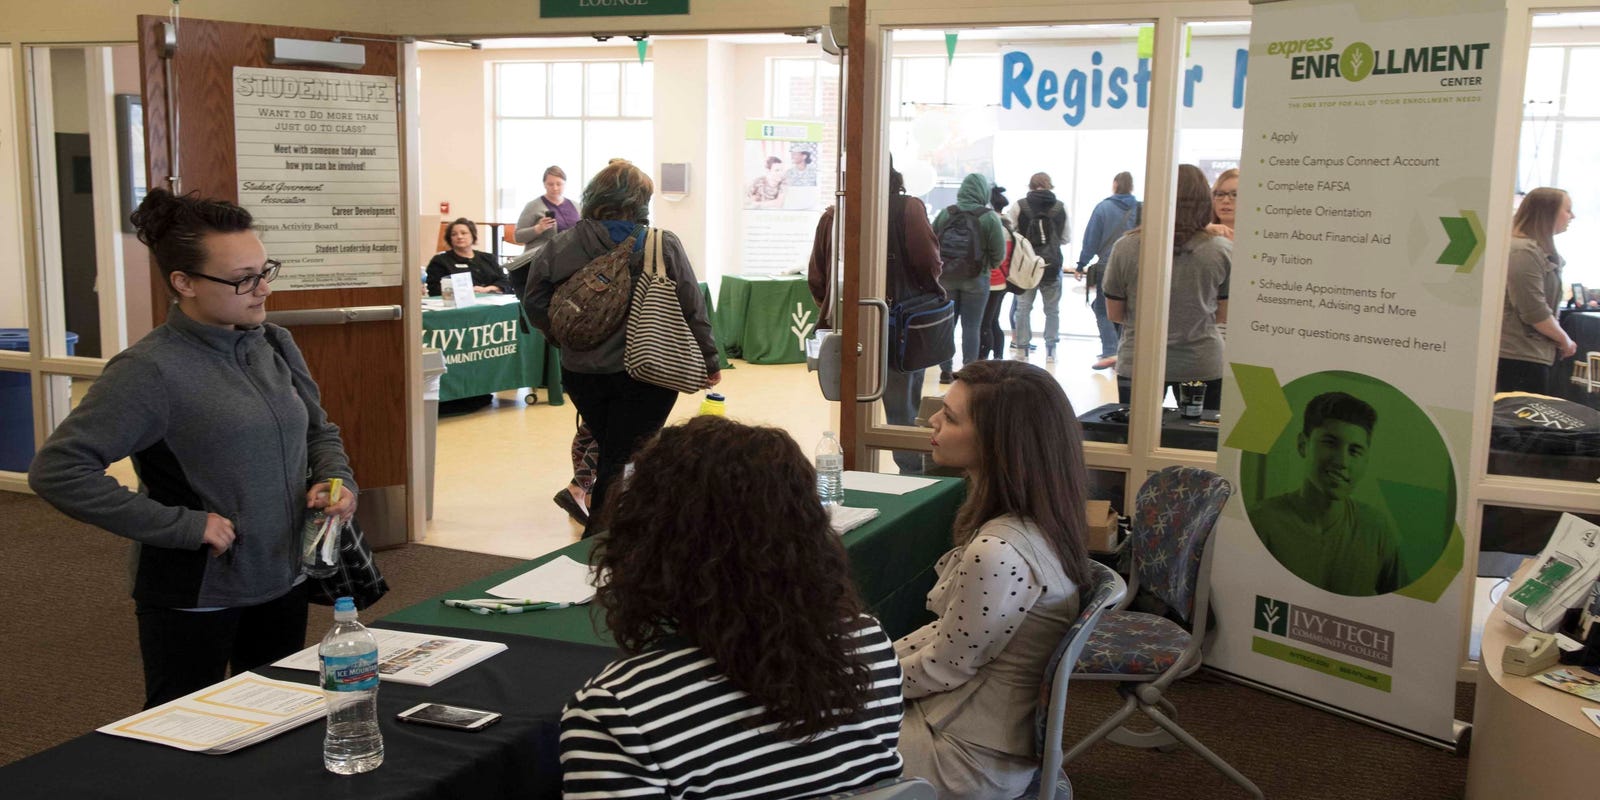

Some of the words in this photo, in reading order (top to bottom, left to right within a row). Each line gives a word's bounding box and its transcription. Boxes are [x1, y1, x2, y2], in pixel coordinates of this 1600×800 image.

[1267, 36, 1334, 58] express
[236, 73, 342, 101] STUDENT
[344, 79, 389, 103] LIFE
[1440, 76, 1482, 87] CENTER
[1001, 51, 1203, 127] Registr
[258, 108, 290, 118] WANT
[294, 110, 306, 119] TO
[310, 110, 323, 119] DO
[327, 112, 353, 120] MORE
[356, 113, 379, 121] THAN
[275, 122, 301, 131] JUST
[304, 124, 317, 132] GO
[320, 124, 332, 132] TO
[335, 124, 367, 133] CLASS?
[1270, 132, 1298, 144] Apply
[274, 143, 292, 155] Meet
[293, 145, 309, 156] with
[310, 147, 340, 156] someone
[341, 146, 359, 158] today
[360, 147, 377, 156] about
[285, 160, 300, 170] how
[301, 162, 314, 172] you
[315, 162, 327, 171] can
[328, 161, 337, 171] be
[338, 161, 366, 171] involved!
[1268, 156, 1300, 167] Create
[1302, 155, 1344, 168] Campus
[1346, 156, 1390, 167] Connect
[1393, 156, 1440, 167] Account
[242, 181, 274, 191] Student
[275, 182, 324, 194] Government
[1266, 180, 1314, 193] Complete
[1317, 181, 1351, 191] FAFSA
[260, 195, 307, 204] Association
[331, 206, 354, 216] Career
[355, 207, 396, 217] Development
[1265, 205, 1313, 217] Complete
[1315, 205, 1372, 218] Orientation
[281, 223, 312, 231] Activity
[314, 222, 338, 230] Board
[1263, 229, 1289, 240] Learn
[1291, 230, 1323, 242] About
[1325, 232, 1368, 244] Financial
[1370, 234, 1391, 245] Aid
[315, 245, 340, 254] Student
[340, 244, 371, 253] Leadership
[373, 243, 398, 252] Academy
[1261, 252, 1278, 265] Pay
[1280, 253, 1312, 265] Tuition
[1259, 279, 1302, 292] Schedule
[1305, 282, 1377, 299] Appointments
[1380, 288, 1397, 299] for
[1256, 293, 1315, 308] Assessment,
[1318, 299, 1361, 314] Advising
[1363, 304, 1385, 314] and
[1388, 305, 1417, 317] More
[431, 328, 466, 350] IVY
[469, 320, 517, 348] TECH
[1250, 320, 1269, 333] Get
[1271, 325, 1295, 336] your
[1297, 328, 1351, 342] questions
[1353, 333, 1411, 349] answered
[1413, 338, 1447, 353] here!
[447, 350, 484, 364] MMUNITY
[483, 344, 517, 358] COLLEGE
[1294, 610, 1328, 633] IVY
[1332, 621, 1389, 652] TECH
[1292, 626, 1350, 650] COMMUNITY
[1350, 644, 1389, 661] COLLEGE
